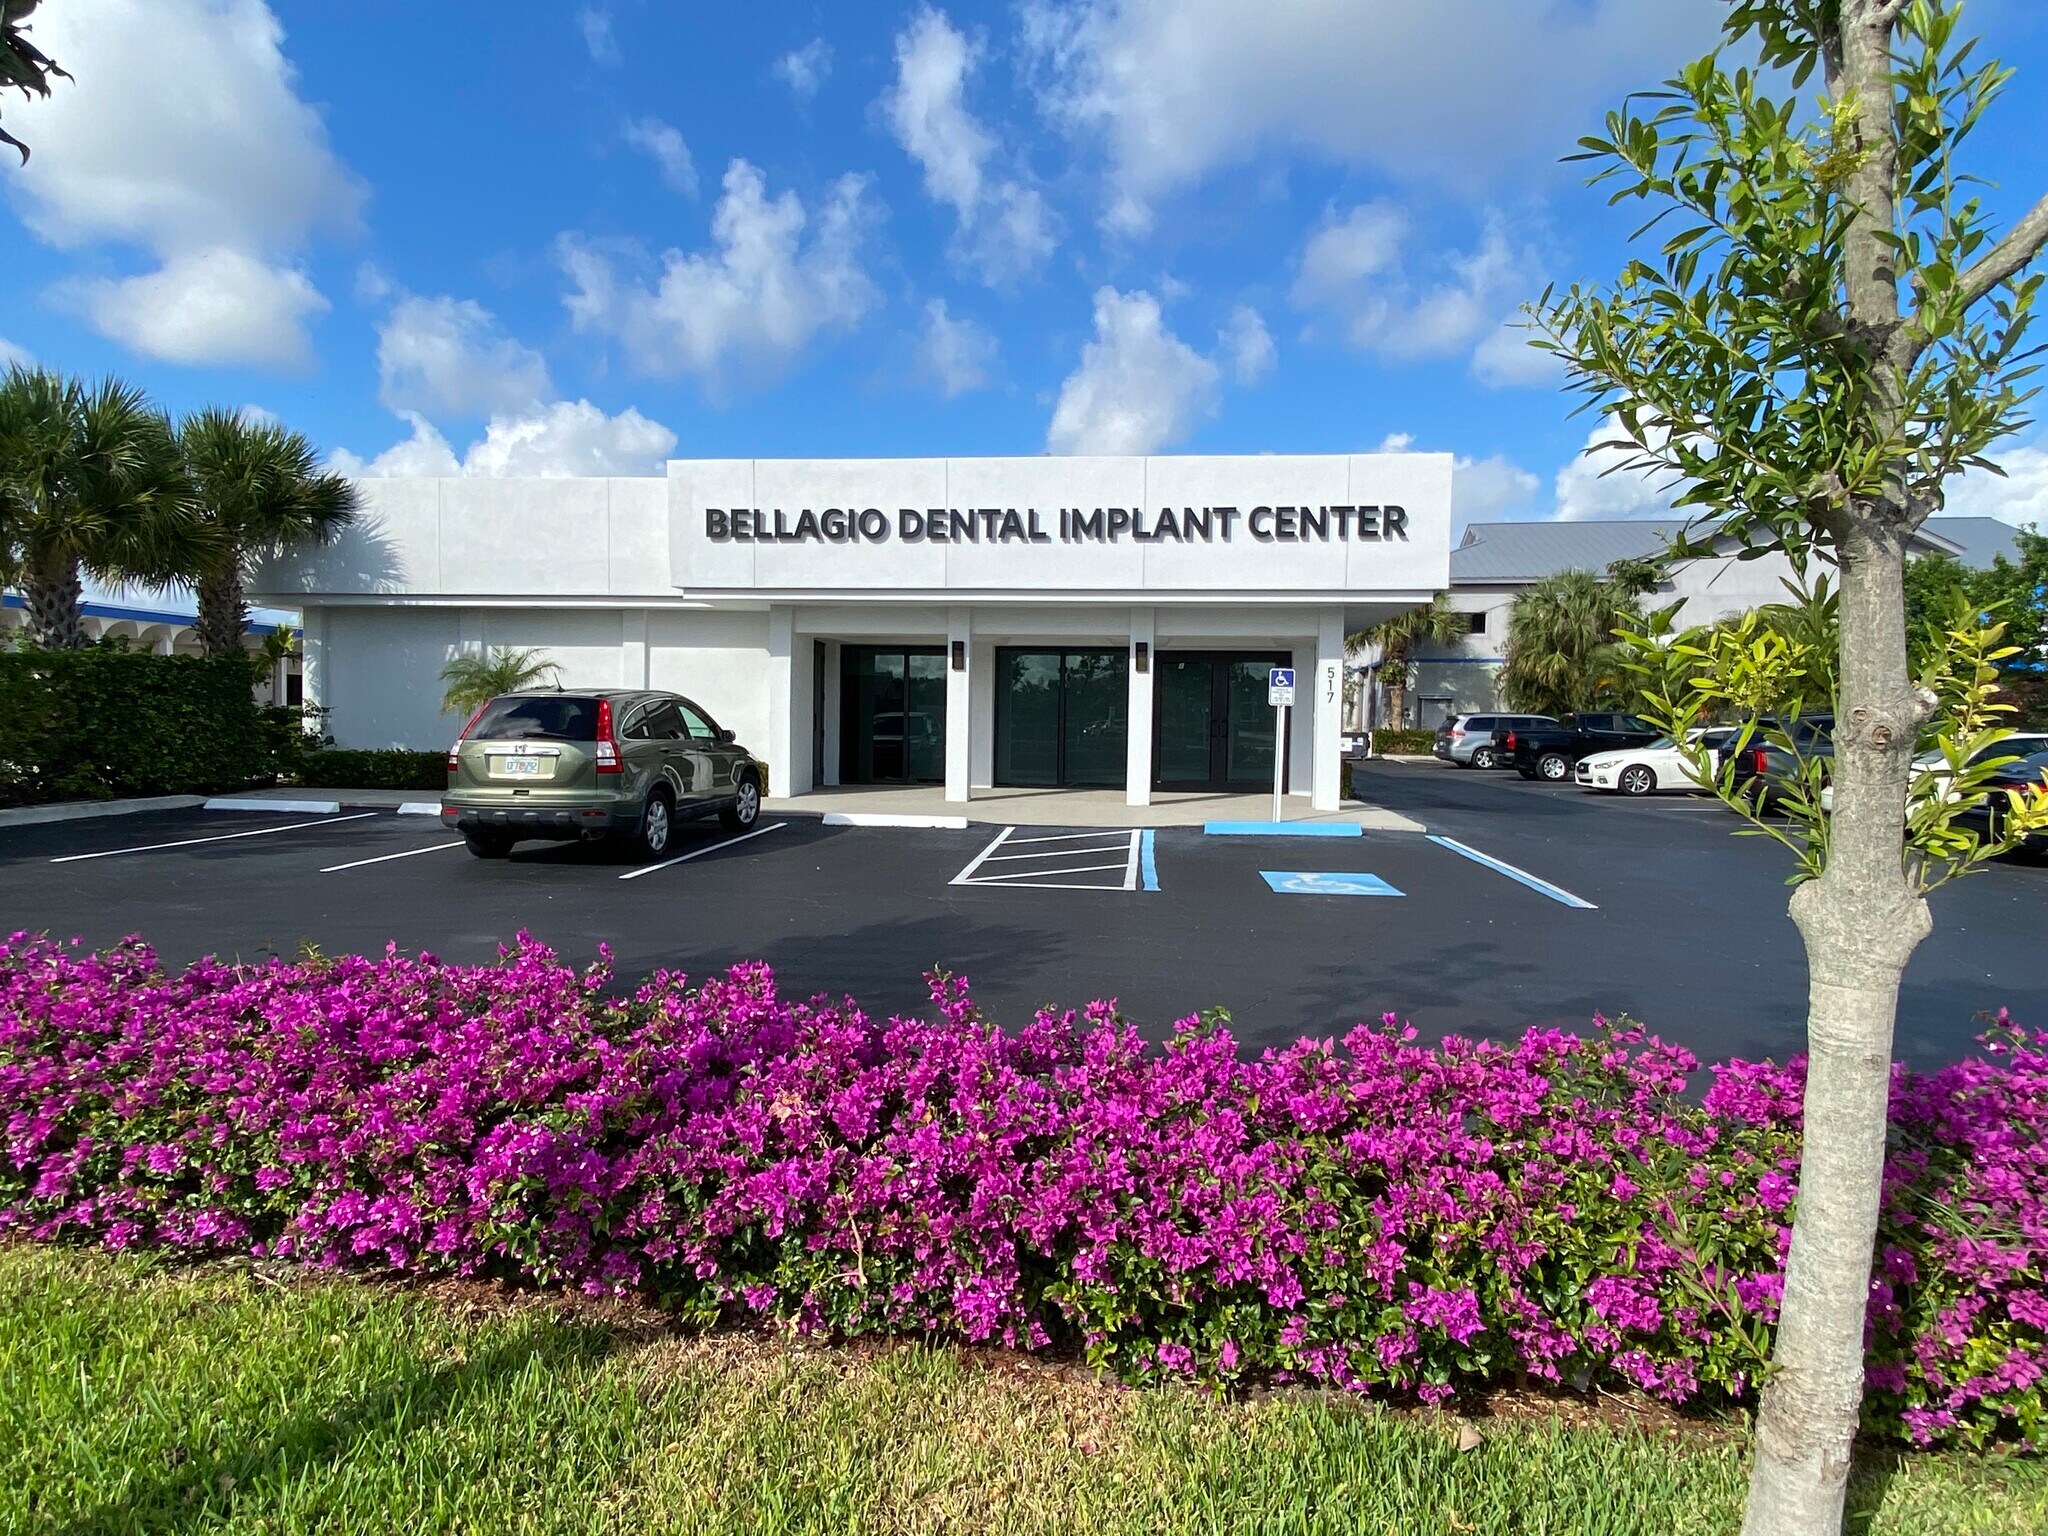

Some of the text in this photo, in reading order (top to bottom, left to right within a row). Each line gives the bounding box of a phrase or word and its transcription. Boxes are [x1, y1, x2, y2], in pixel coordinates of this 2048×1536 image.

[706, 505, 1407, 540] BELLAGIO DENTAL IMPLANT CENTER
[1327, 667, 1335, 704] 517
